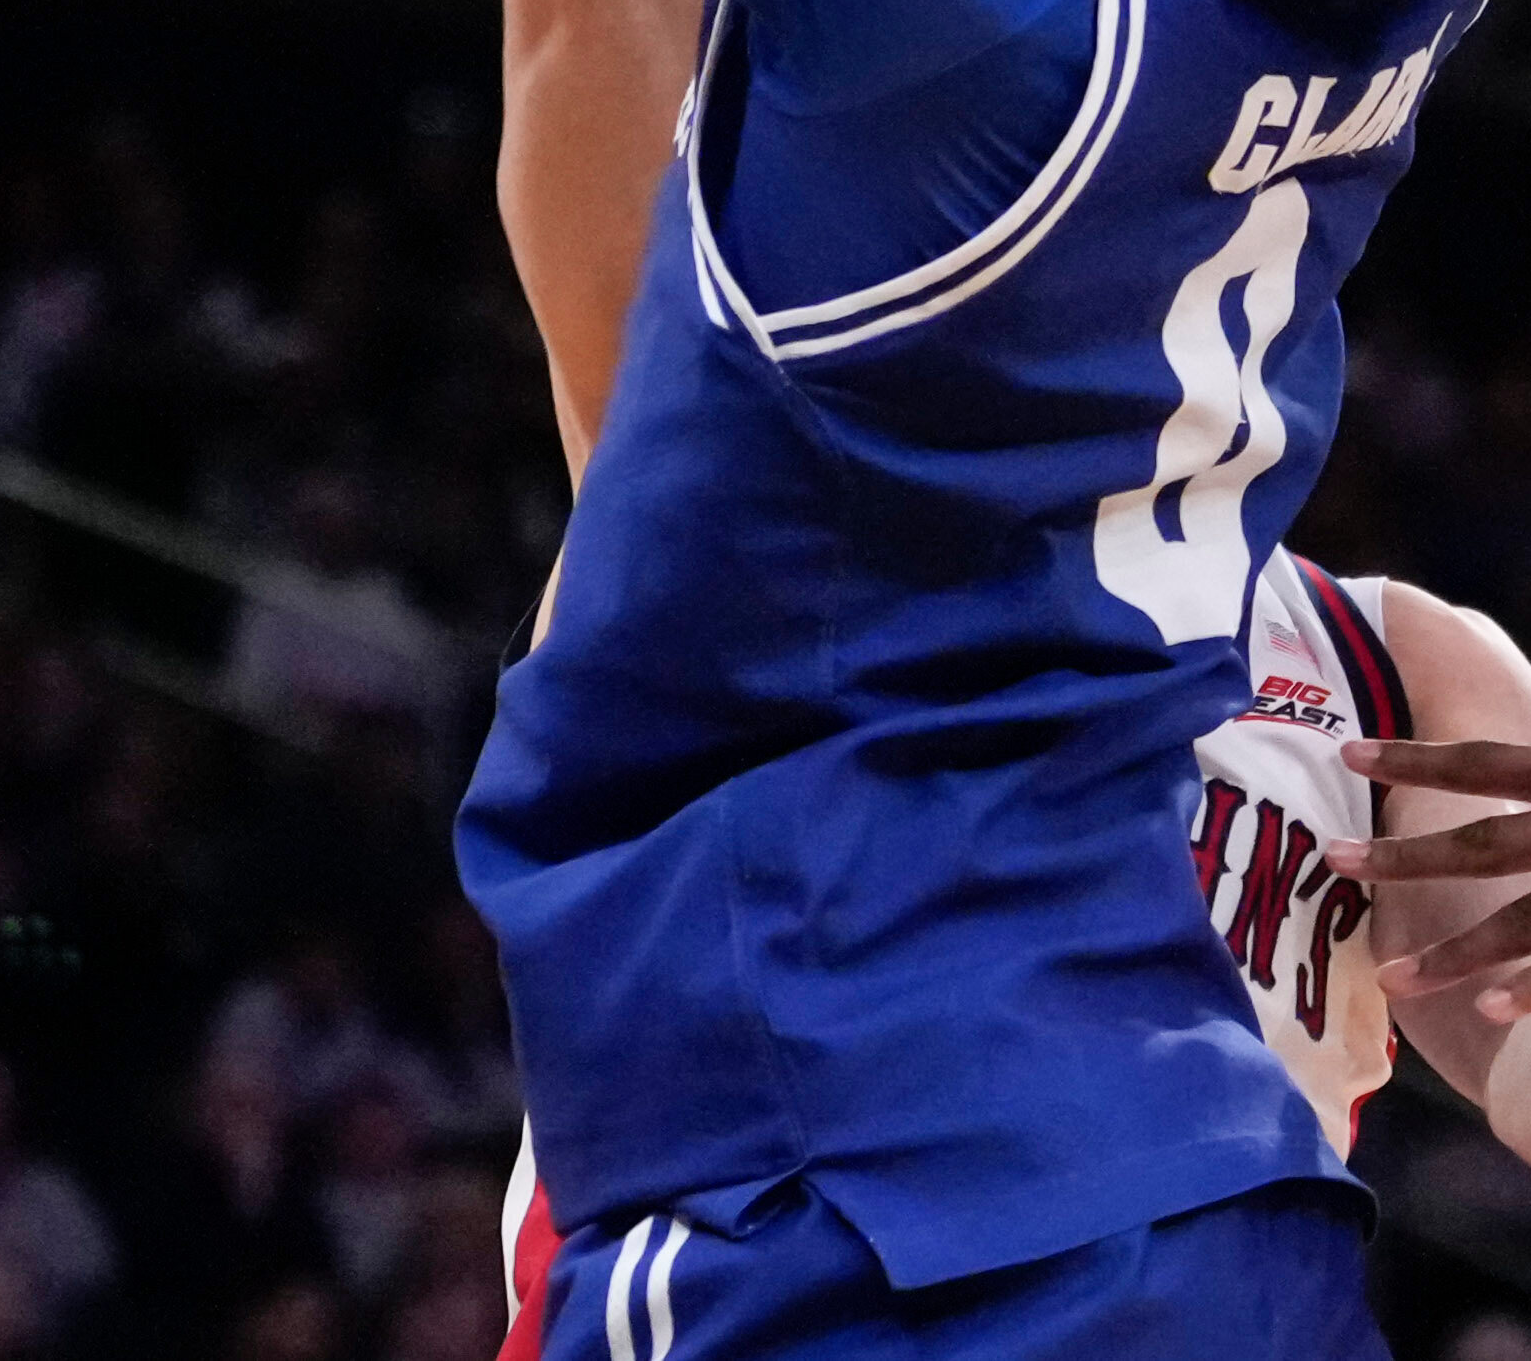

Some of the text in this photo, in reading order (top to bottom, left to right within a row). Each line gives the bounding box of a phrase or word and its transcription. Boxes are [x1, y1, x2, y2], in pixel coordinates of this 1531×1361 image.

[1092, 176, 1311, 647] 0
[1257, 675, 1332, 706] BIG
[1252, 695, 1347, 730] EAST
